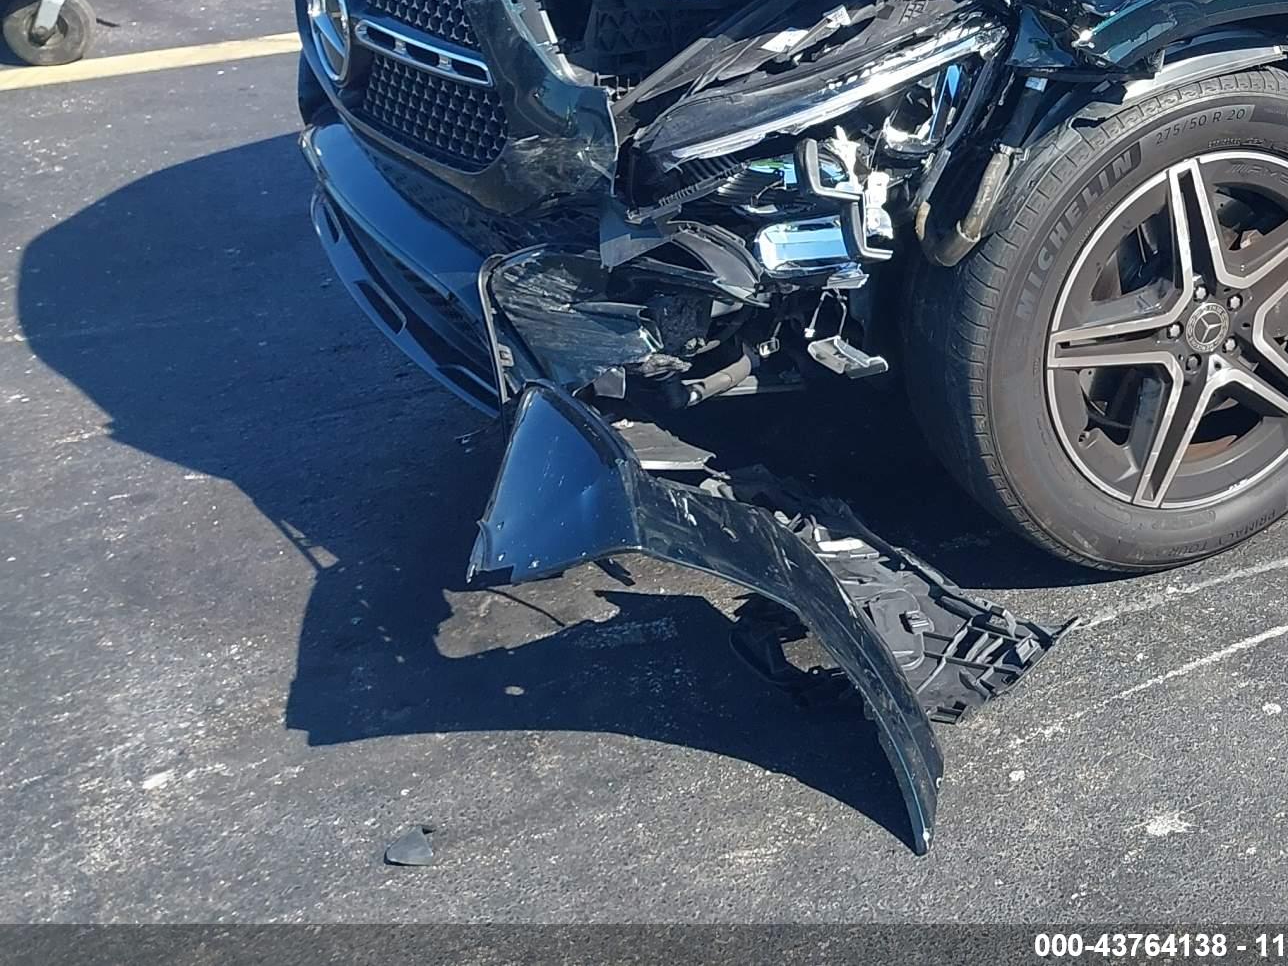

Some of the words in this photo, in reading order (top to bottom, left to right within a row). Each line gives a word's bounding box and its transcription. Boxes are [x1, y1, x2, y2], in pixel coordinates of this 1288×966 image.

[1155, 113, 1208, 146] 275/50
[1212, 112, 1223, 124] R
[1227, 108, 1246, 121] 20
[1015, 148, 1135, 319] MICHELIN
